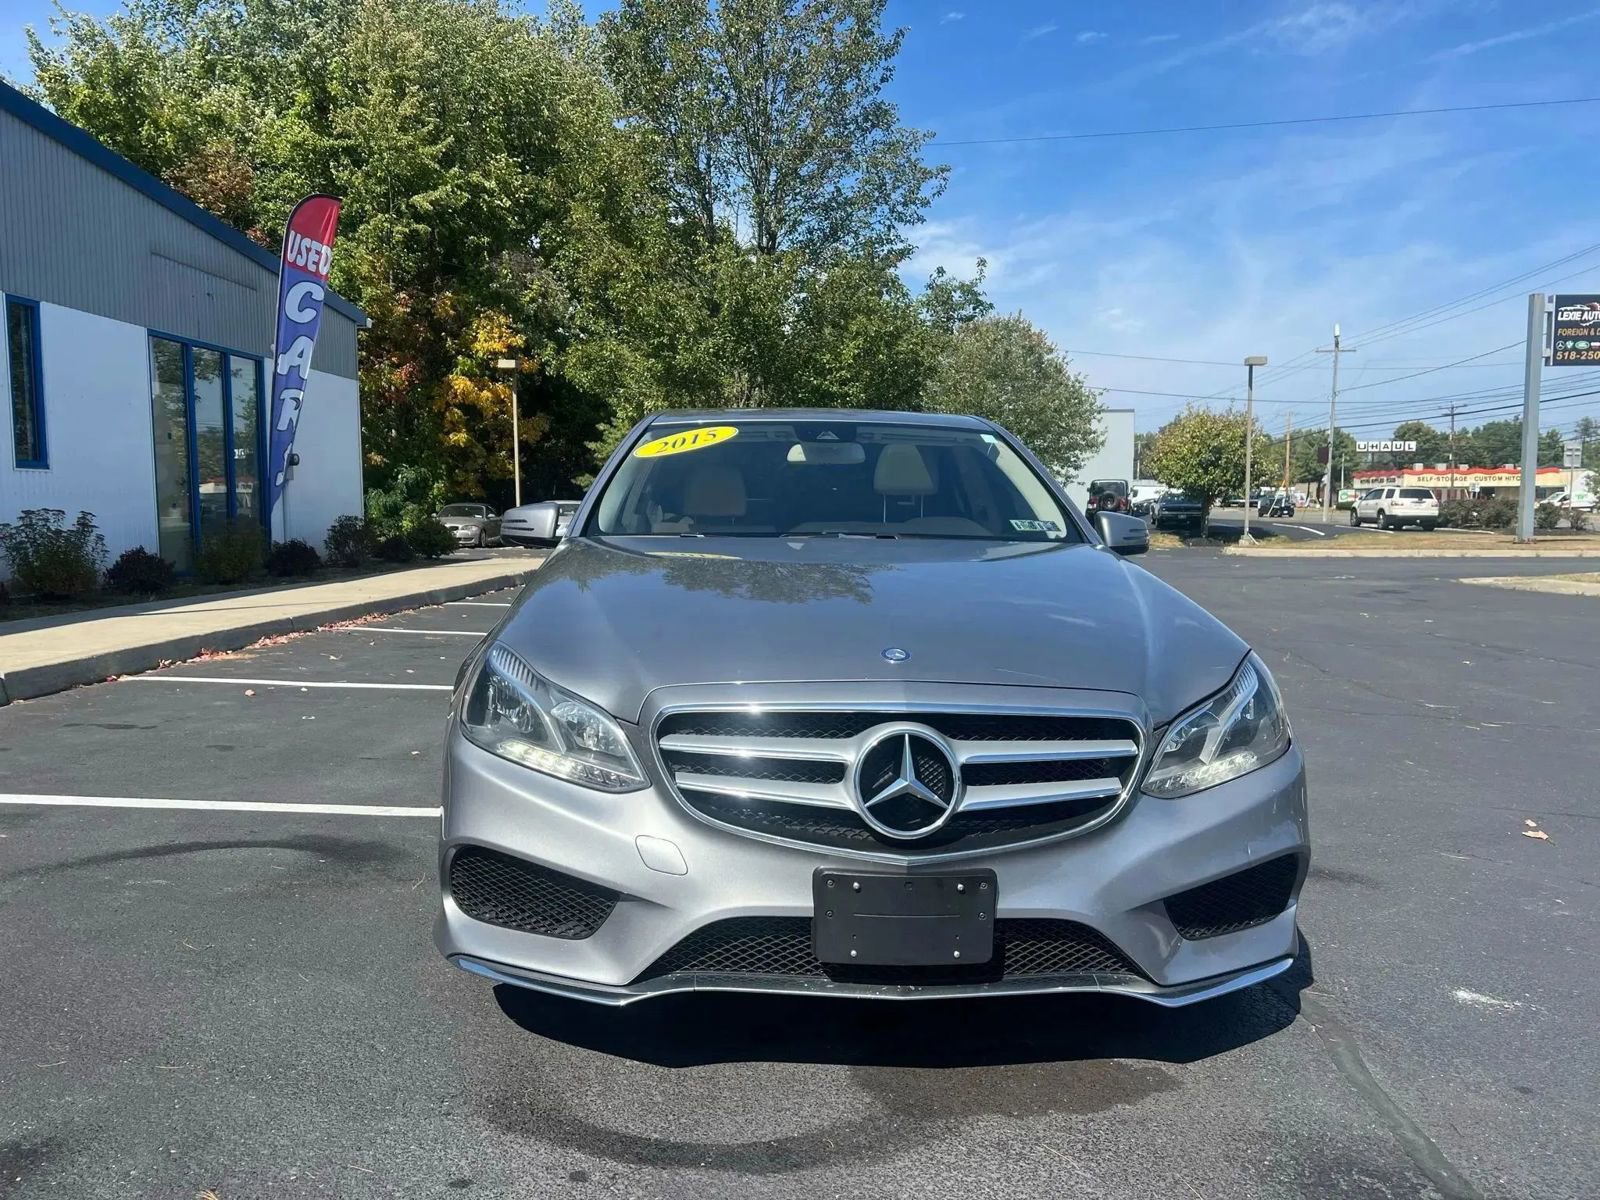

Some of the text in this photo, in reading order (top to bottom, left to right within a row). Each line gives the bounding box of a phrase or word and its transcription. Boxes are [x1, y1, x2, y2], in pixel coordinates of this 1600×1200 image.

[287, 230, 333, 275] USED
[1558, 311, 1600, 321] LEXIE AUT
[1557, 328, 1589, 336] FOREIGN
[1556, 351, 1600, 360] 518-250
[656, 429, 717, 453] 2015
